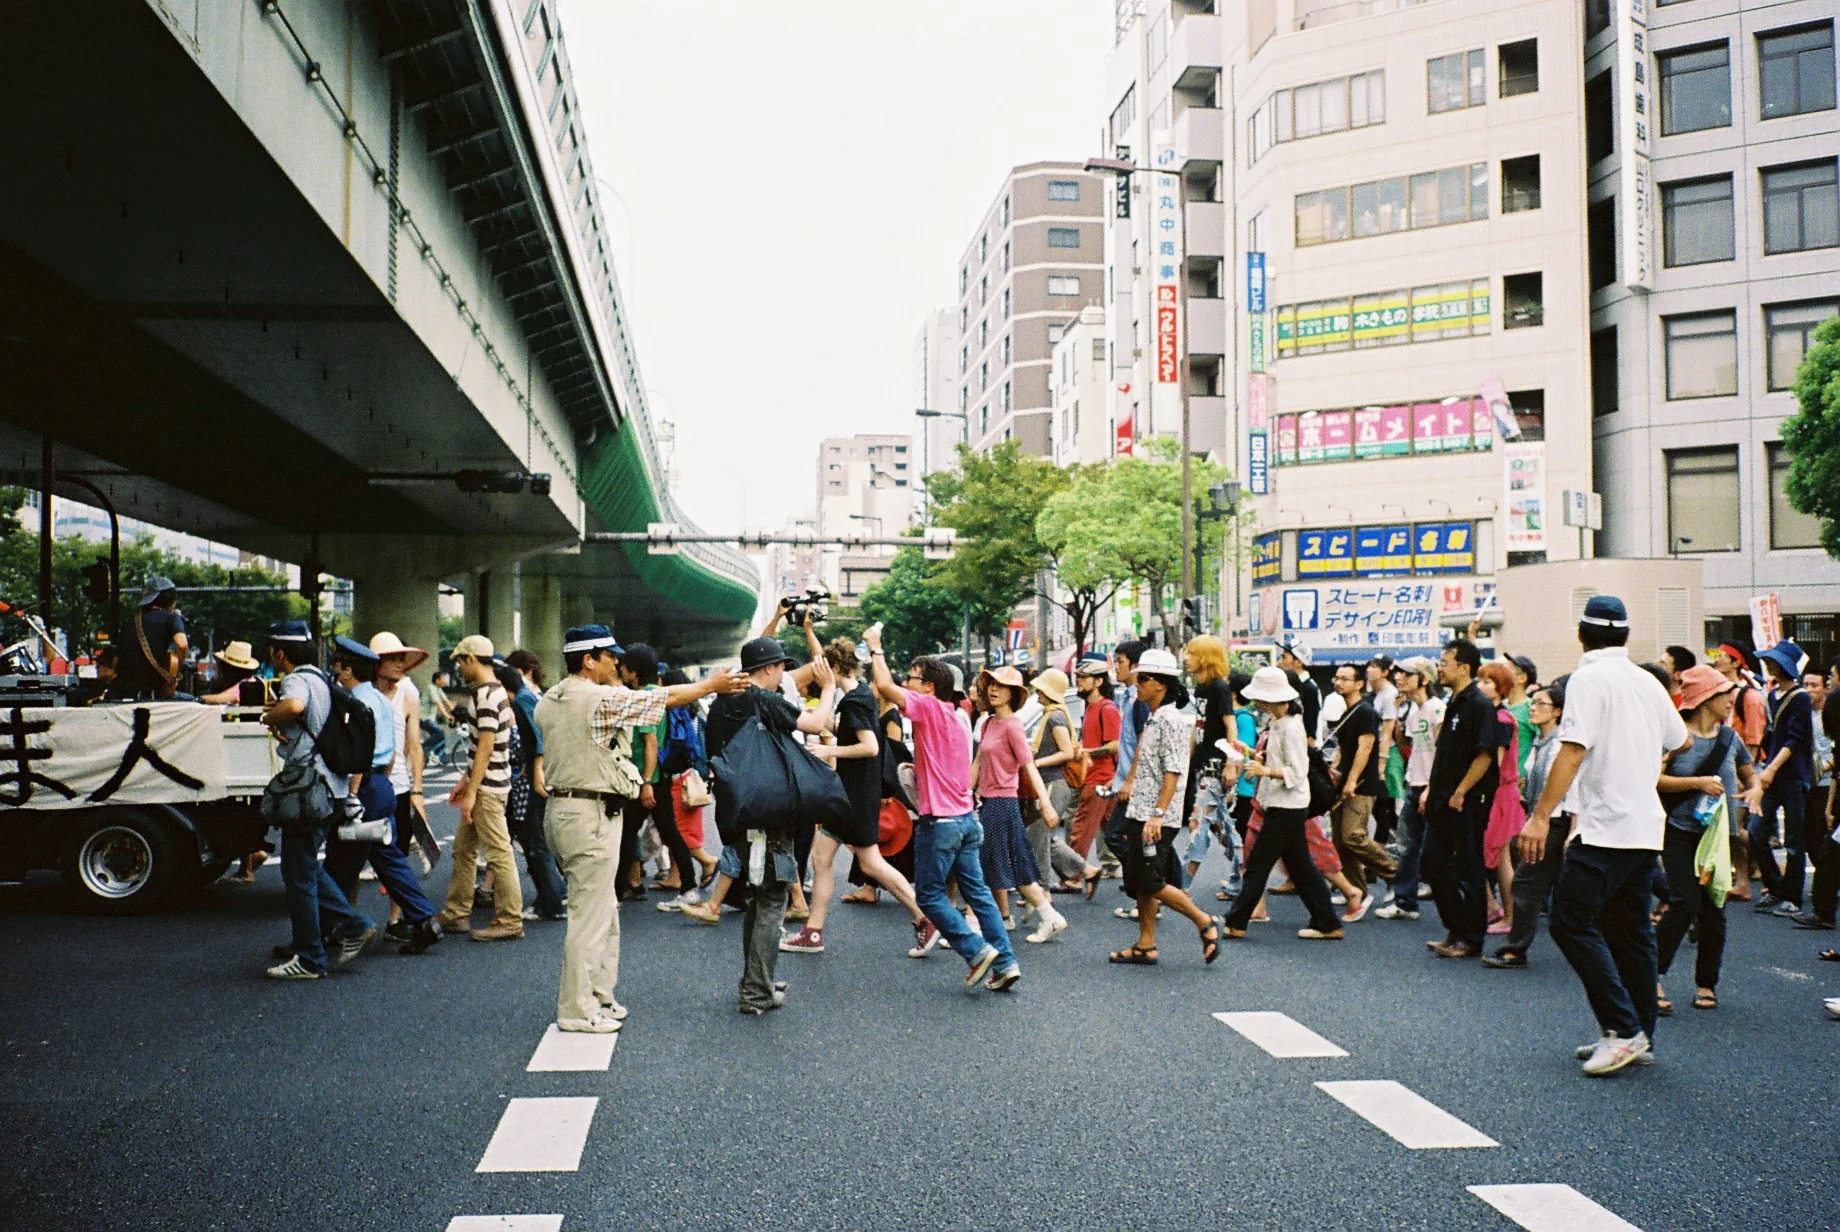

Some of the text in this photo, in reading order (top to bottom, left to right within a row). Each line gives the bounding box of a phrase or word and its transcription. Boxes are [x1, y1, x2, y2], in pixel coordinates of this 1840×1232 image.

[1302, 412, 1463, 447] ホームメイト
